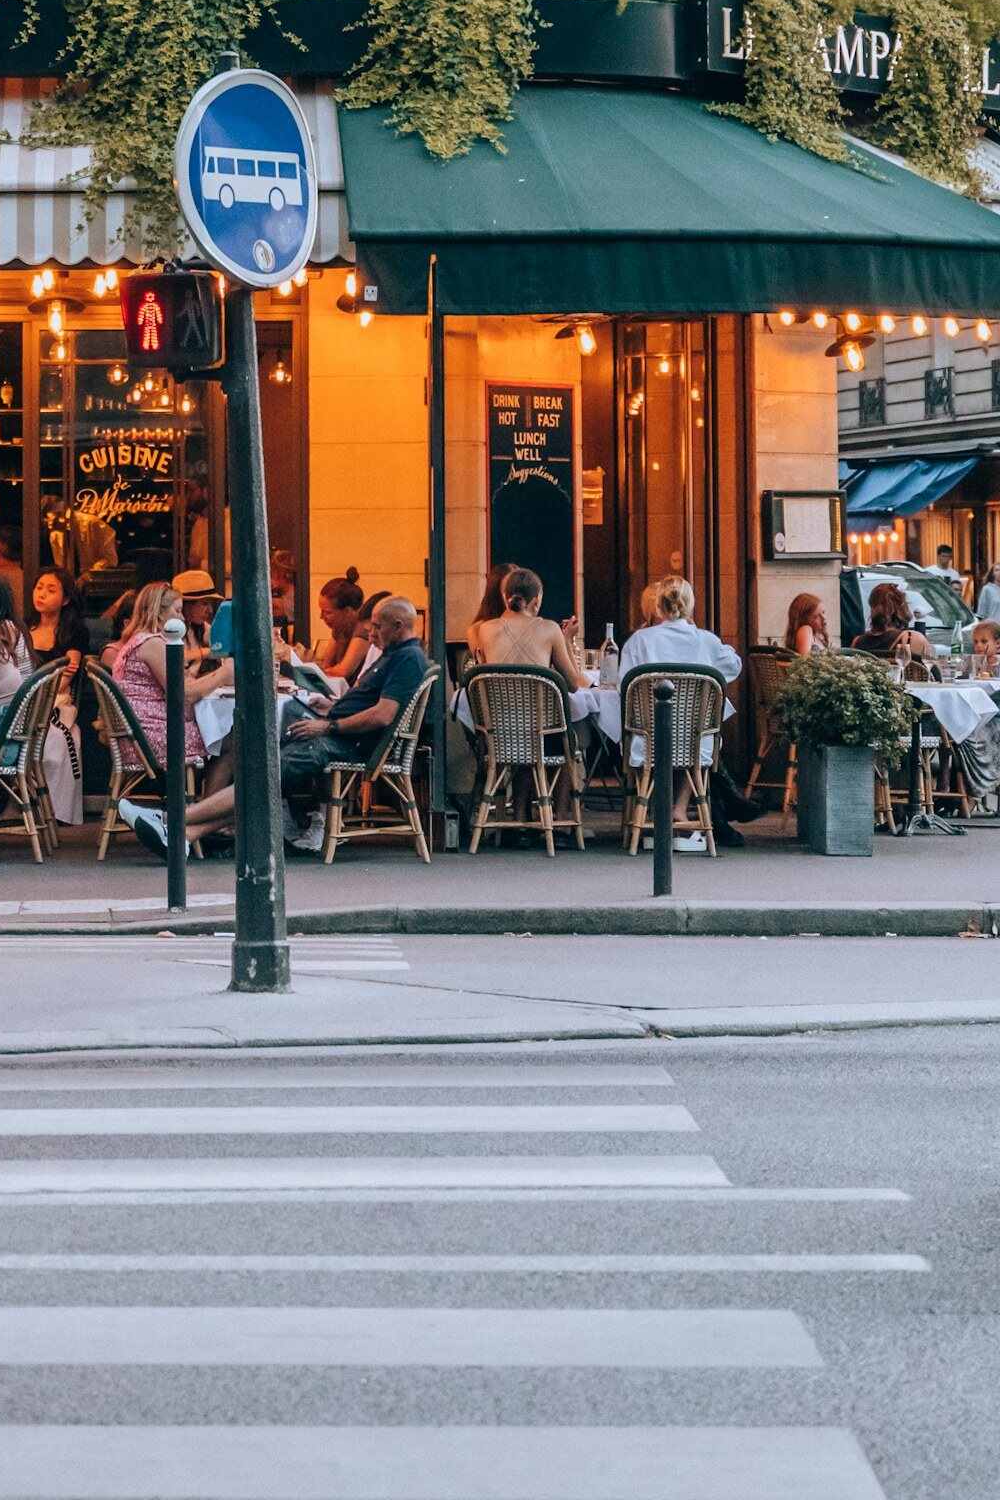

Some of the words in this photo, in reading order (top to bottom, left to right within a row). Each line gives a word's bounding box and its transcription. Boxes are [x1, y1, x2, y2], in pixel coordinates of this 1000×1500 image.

[493, 394, 521, 408] DRINK
[533, 396, 564, 410] BREAK
[498, 411, 517, 425] HOT
[537, 413, 560, 428] FAST
[514, 432, 546, 446] LUNCH
[79, 445, 174, 475] CUISINE
[514, 447, 542, 461] WELL
[503, 463, 559, 486] Suggestions
[112, 474, 131, 490] de
